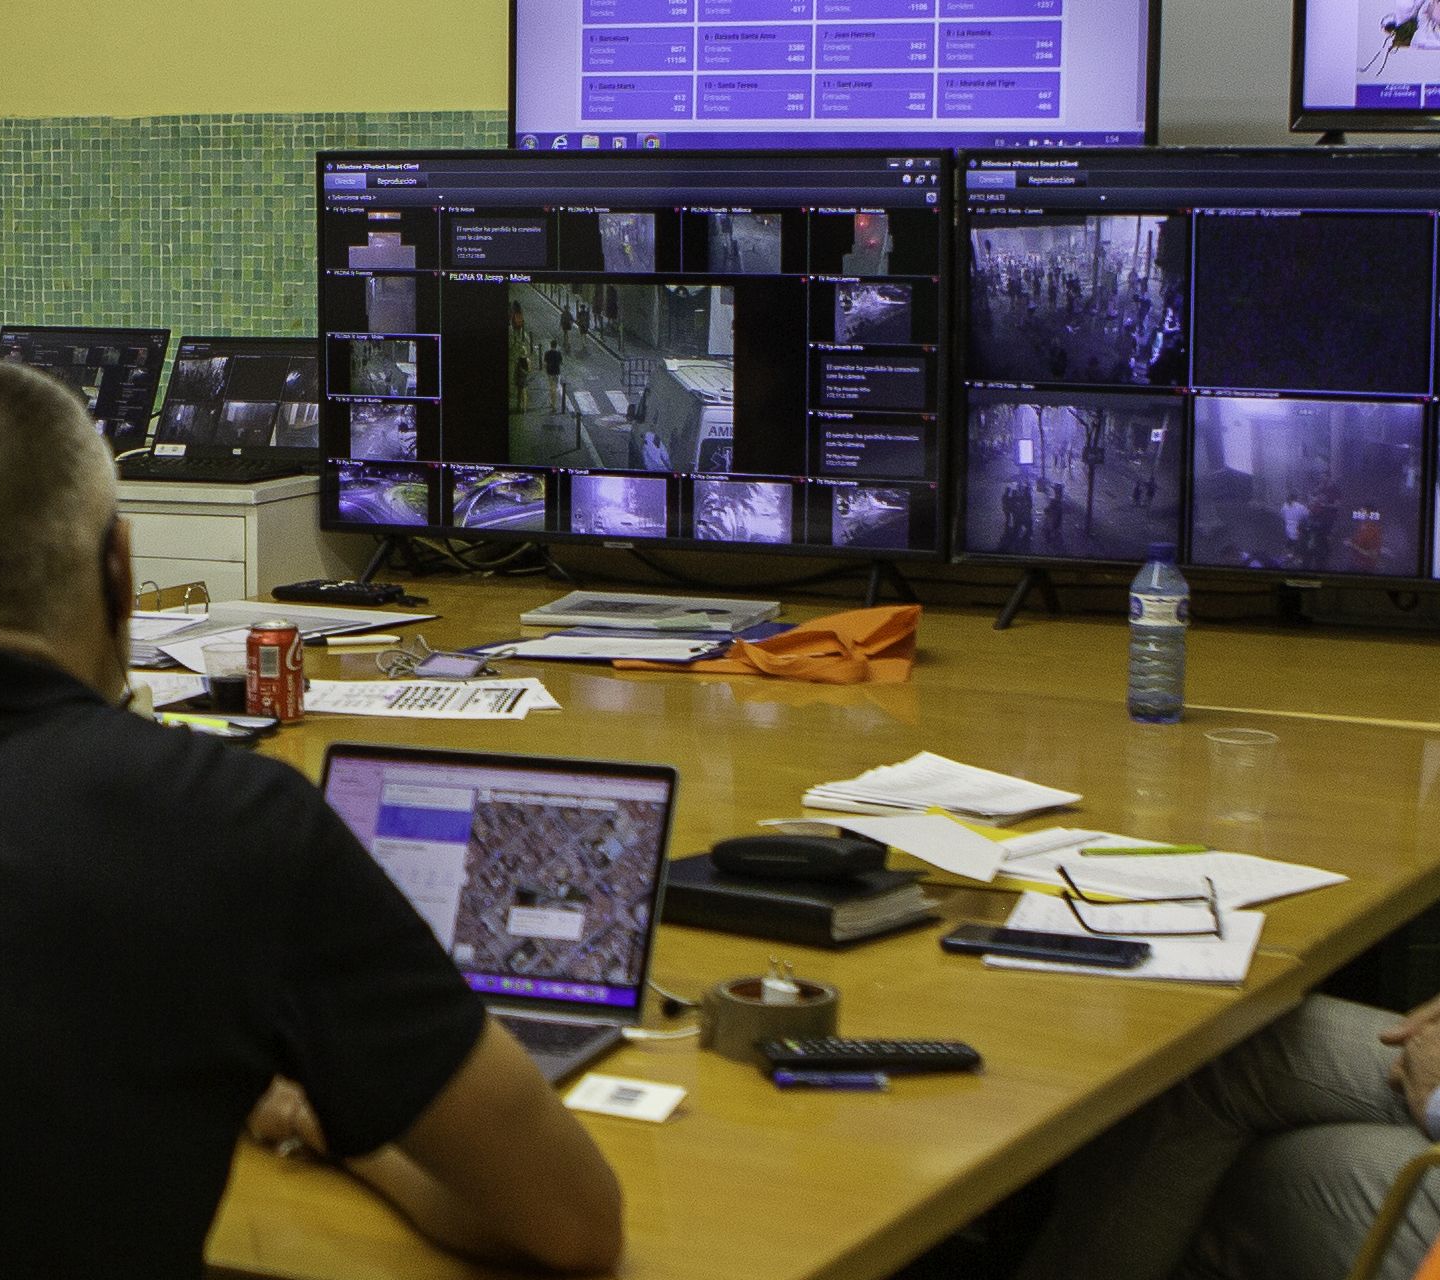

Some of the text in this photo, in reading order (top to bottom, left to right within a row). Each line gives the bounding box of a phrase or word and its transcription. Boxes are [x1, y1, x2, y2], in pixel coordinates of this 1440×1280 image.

[377, 176, 417, 187] Reproducción
[1028, 174, 1076, 186] Reproducción
[449, 273, 475, 282] PILONA
